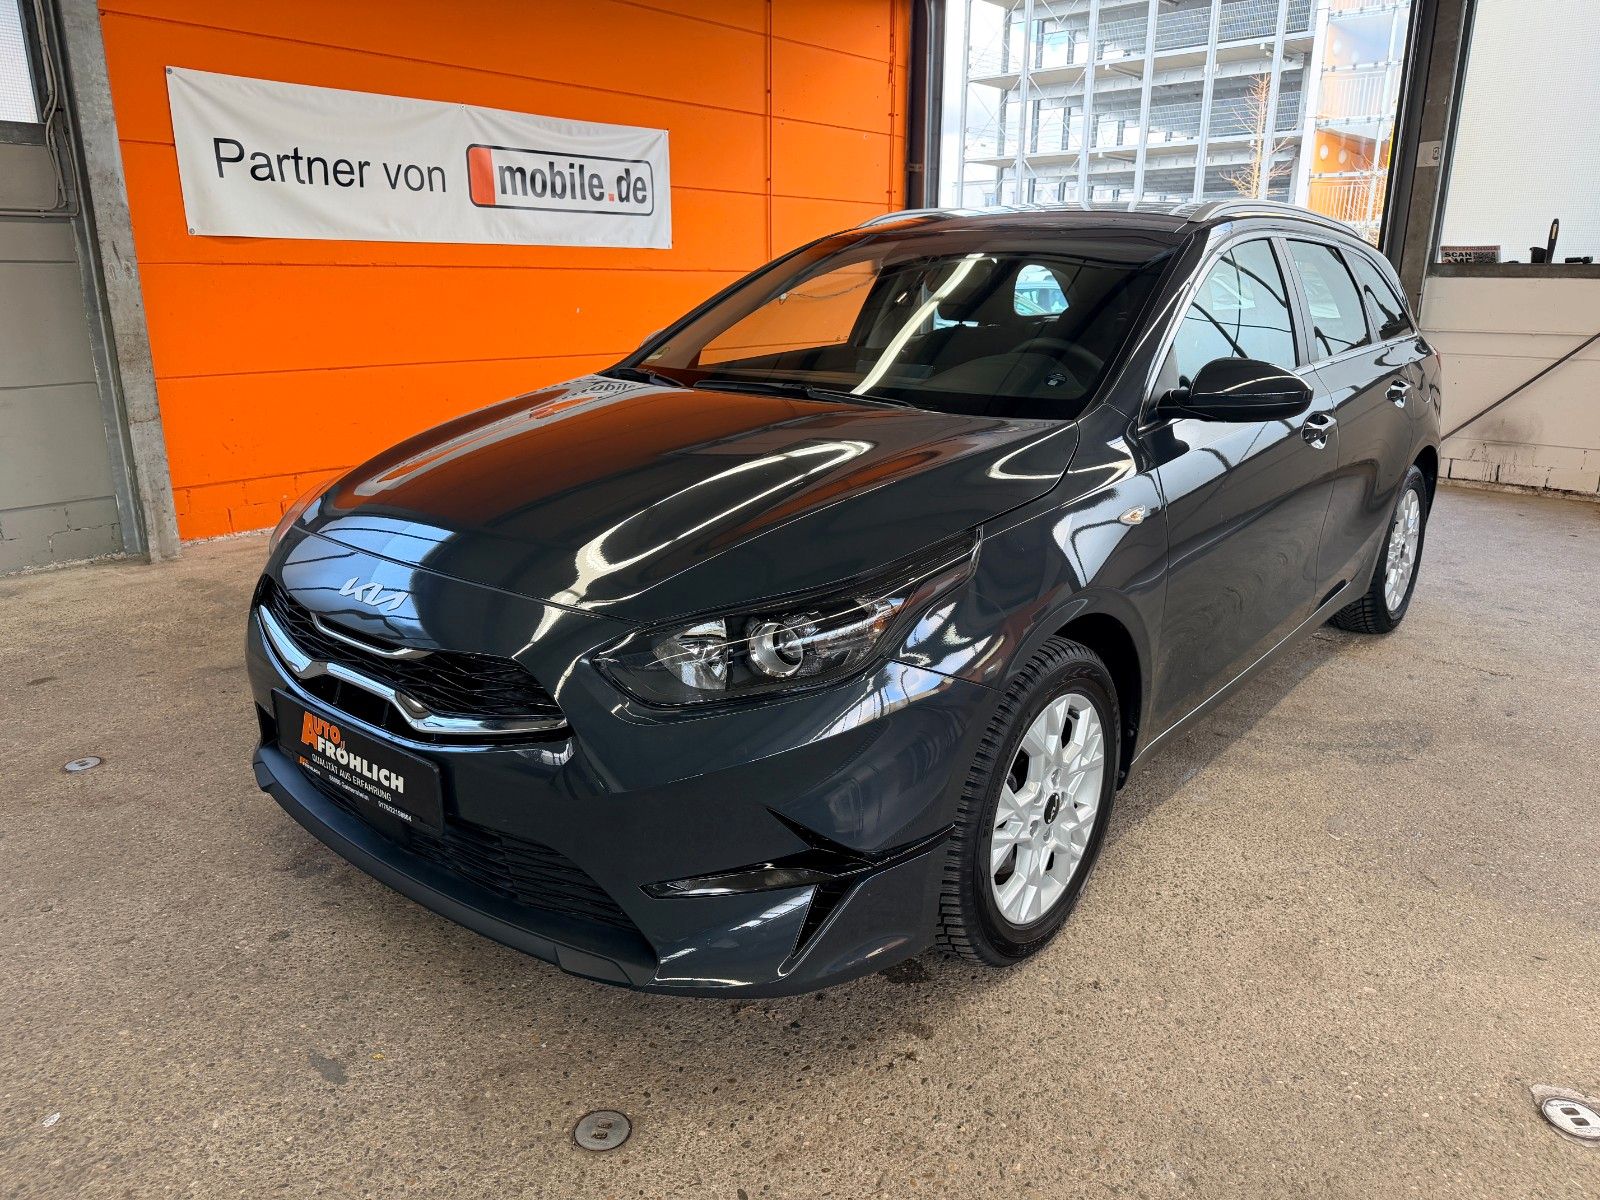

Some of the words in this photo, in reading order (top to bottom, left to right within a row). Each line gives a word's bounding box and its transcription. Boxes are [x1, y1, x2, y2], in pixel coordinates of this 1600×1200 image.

[213, 136, 371, 189] Partner
[383, 163, 447, 193] von
[499, 160, 648, 205] mobile.de
[338, 576, 409, 612] KIA
[301, 710, 342, 750] AUTO
[317, 735, 405, 794] FRÖHLICH
[339, 768, 352, 782] AUS
[352, 774, 393, 802] ERFAHRUNG
